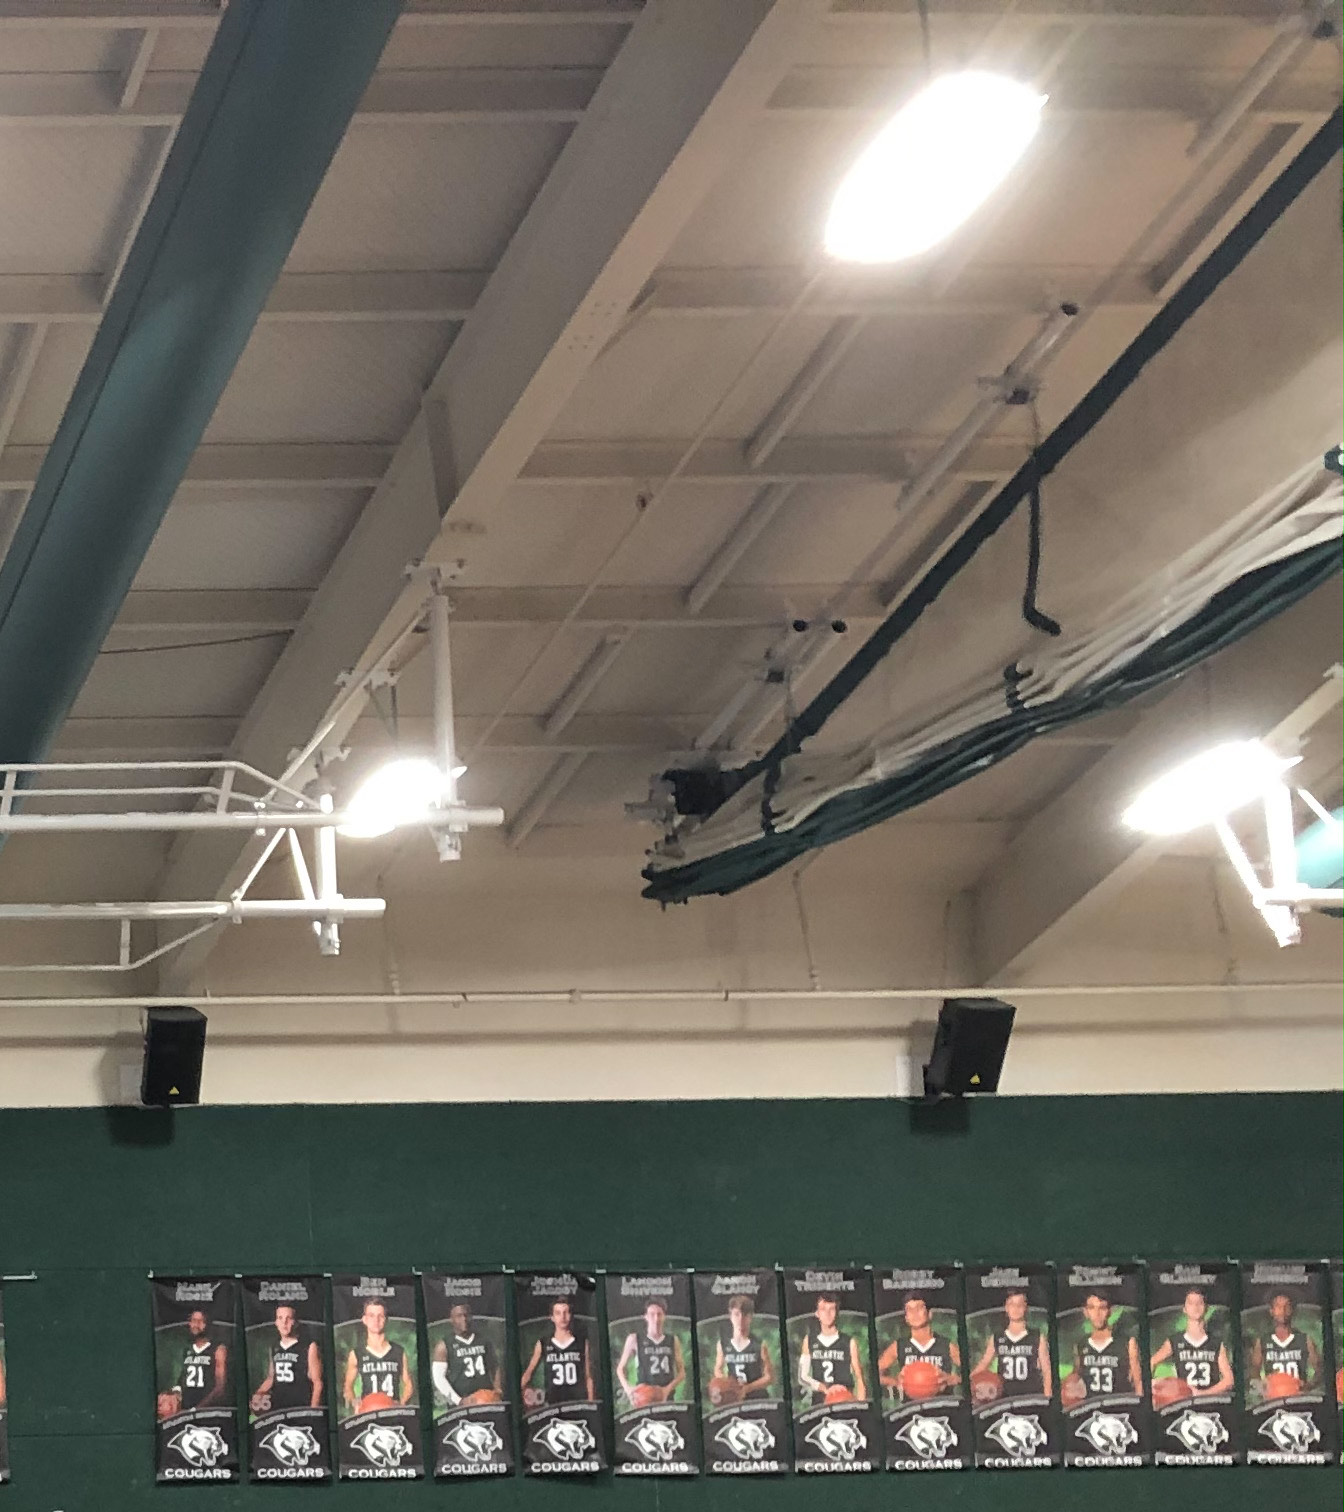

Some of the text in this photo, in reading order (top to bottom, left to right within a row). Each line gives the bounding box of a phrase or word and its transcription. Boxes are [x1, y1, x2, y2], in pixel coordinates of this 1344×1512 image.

[456, 1345, 486, 1357] ATLANTIC
[546, 1351, 581, 1363] ATLANTIC
[362, 1361, 399, 1373] ATLANTIC
[463, 1355, 486, 1378] 34
[649, 1355, 670, 1375] 24
[1002, 1357, 1029, 1381] 30
[186, 1366, 205, 1387] 21
[275, 1362, 295, 1382] 55
[552, 1363, 578, 1385] 30
[734, 1364, 747, 1383] 5
[821, 1361, 835, 1383] 2
[1185, 1362, 1212, 1386] 23
[370, 1374, 395, 1396] 14
[1090, 1368, 1113, 1392] 33
[712, 1460, 779, 1472] COUGARS
[895, 1459, 963, 1471] COUGARS
[984, 1456, 1053, 1468] COUGARS
[1074, 1456, 1143, 1468] COUGARS
[1164, 1455, 1233, 1466] COUGARS
[257, 1467, 325, 1479] COUGARS
[441, 1462, 507, 1474] COUGARS
[531, 1461, 600, 1473] COUGARS
[621, 1462, 689, 1473] COUGARS
[804, 1461, 872, 1473] COUGARS
[164, 1468, 232, 1479] COUGARS
[348, 1468, 417, 1479] COUGARS
